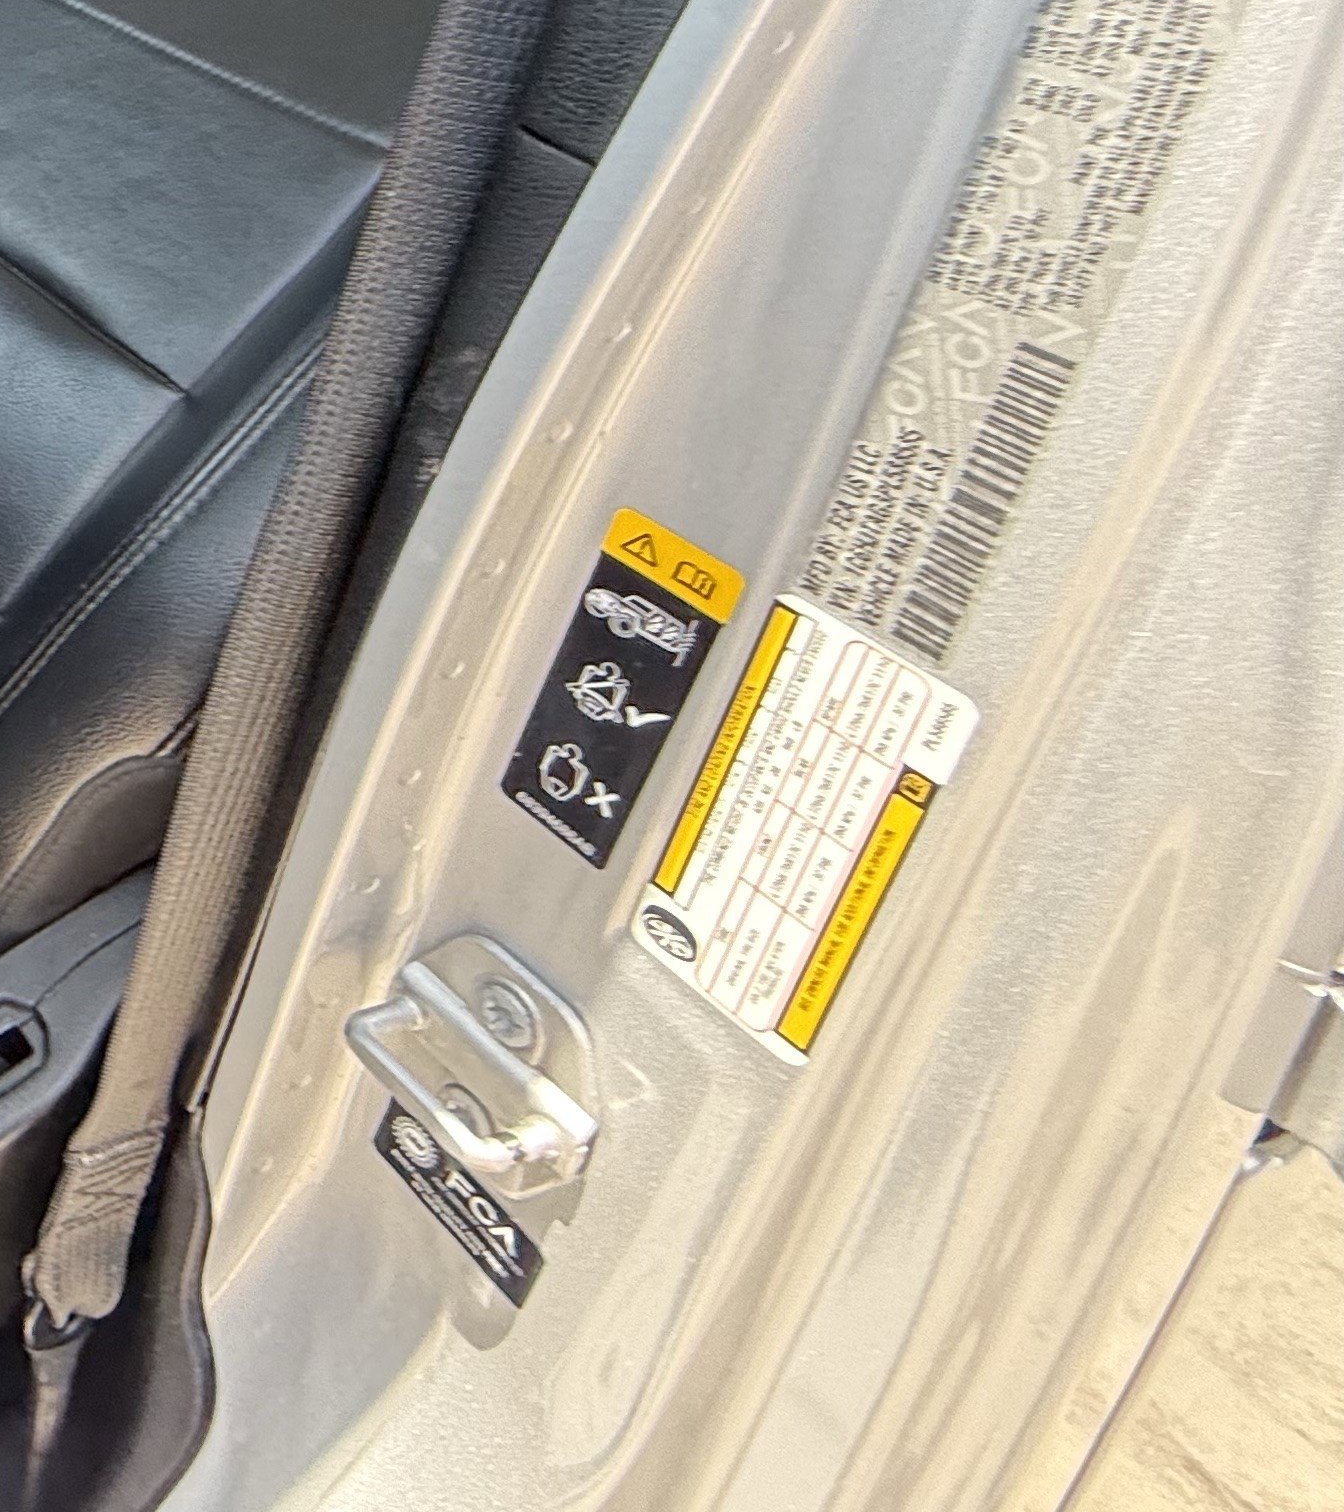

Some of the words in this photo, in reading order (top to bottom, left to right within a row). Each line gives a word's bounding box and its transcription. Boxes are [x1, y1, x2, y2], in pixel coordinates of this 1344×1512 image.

[848, 442, 880, 475] LLC
[838, 471, 868, 498] US
[825, 497, 858, 532] FCA
[854, 561, 900, 626] VEHICLE
[882, 515, 920, 564] MADE
[913, 444, 954, 493] U.S.A.
[799, 557, 833, 596] MFD
